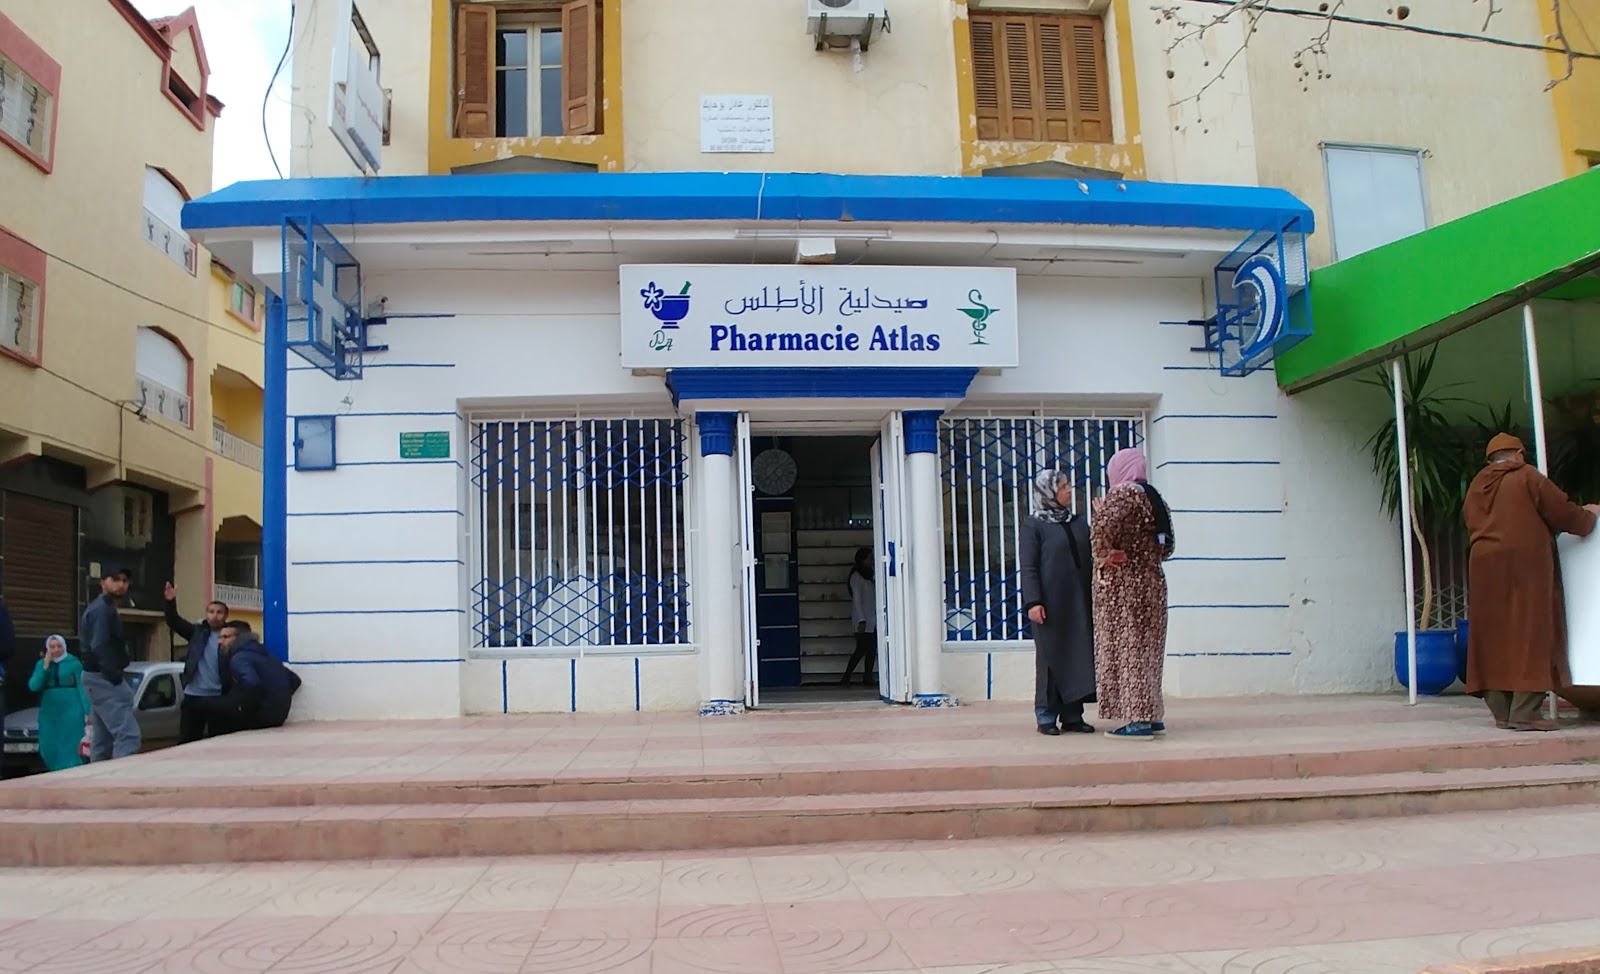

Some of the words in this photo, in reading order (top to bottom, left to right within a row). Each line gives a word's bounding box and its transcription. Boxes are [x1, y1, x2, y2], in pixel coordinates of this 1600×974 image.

[724, 279, 824, 315] الأطلس
[839, 286, 928, 317] صيدلية
[710, 323, 860, 352] Pharmacie
[869, 324, 941, 352] Atlas
